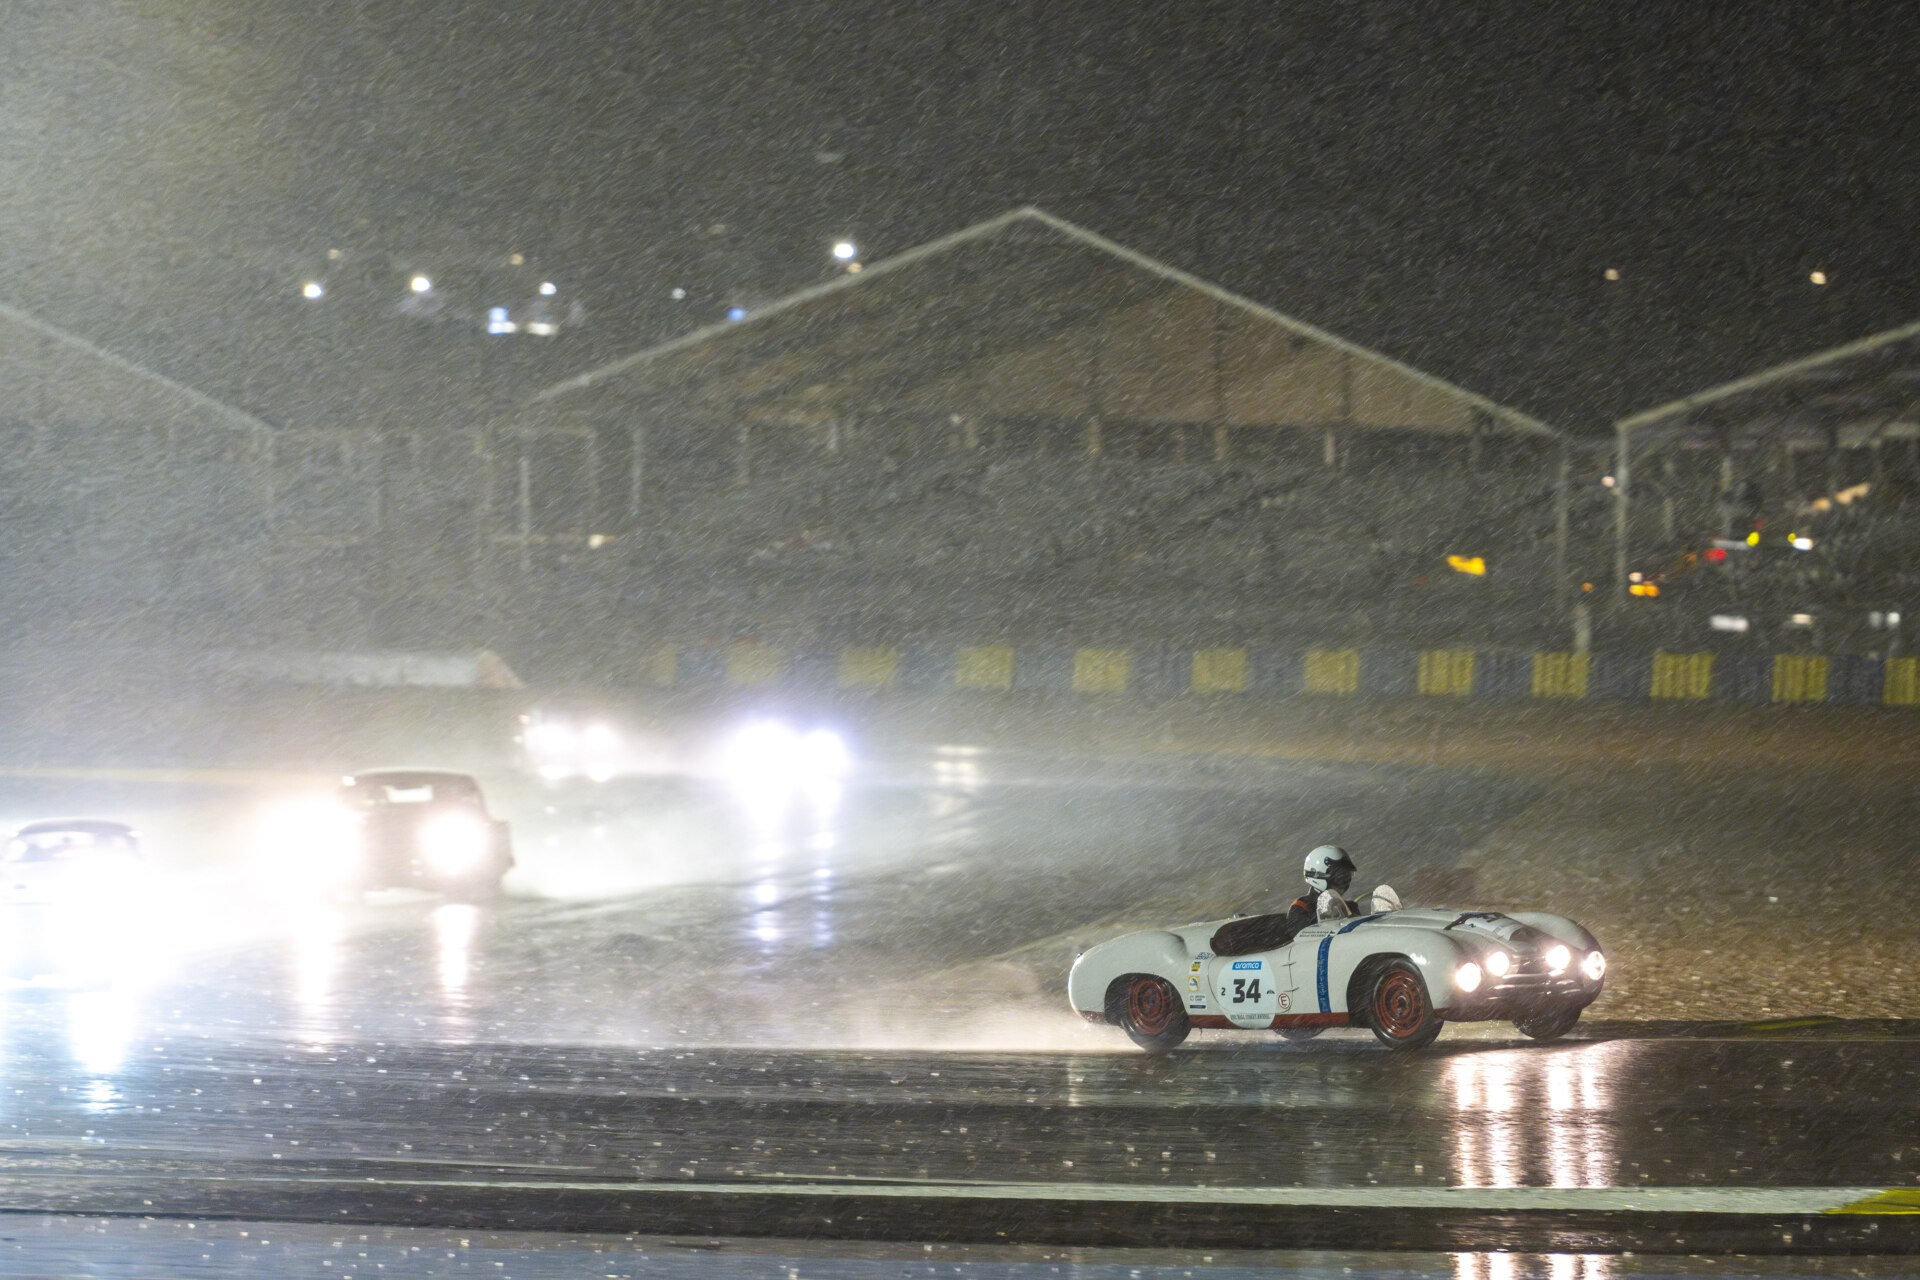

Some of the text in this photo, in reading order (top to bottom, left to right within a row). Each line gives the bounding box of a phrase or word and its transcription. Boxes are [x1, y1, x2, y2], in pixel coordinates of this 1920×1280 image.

[1221, 987, 1226, 996] 2
[1232, 978, 1261, 1003] 34
[1281, 996, 1287, 1007] E
